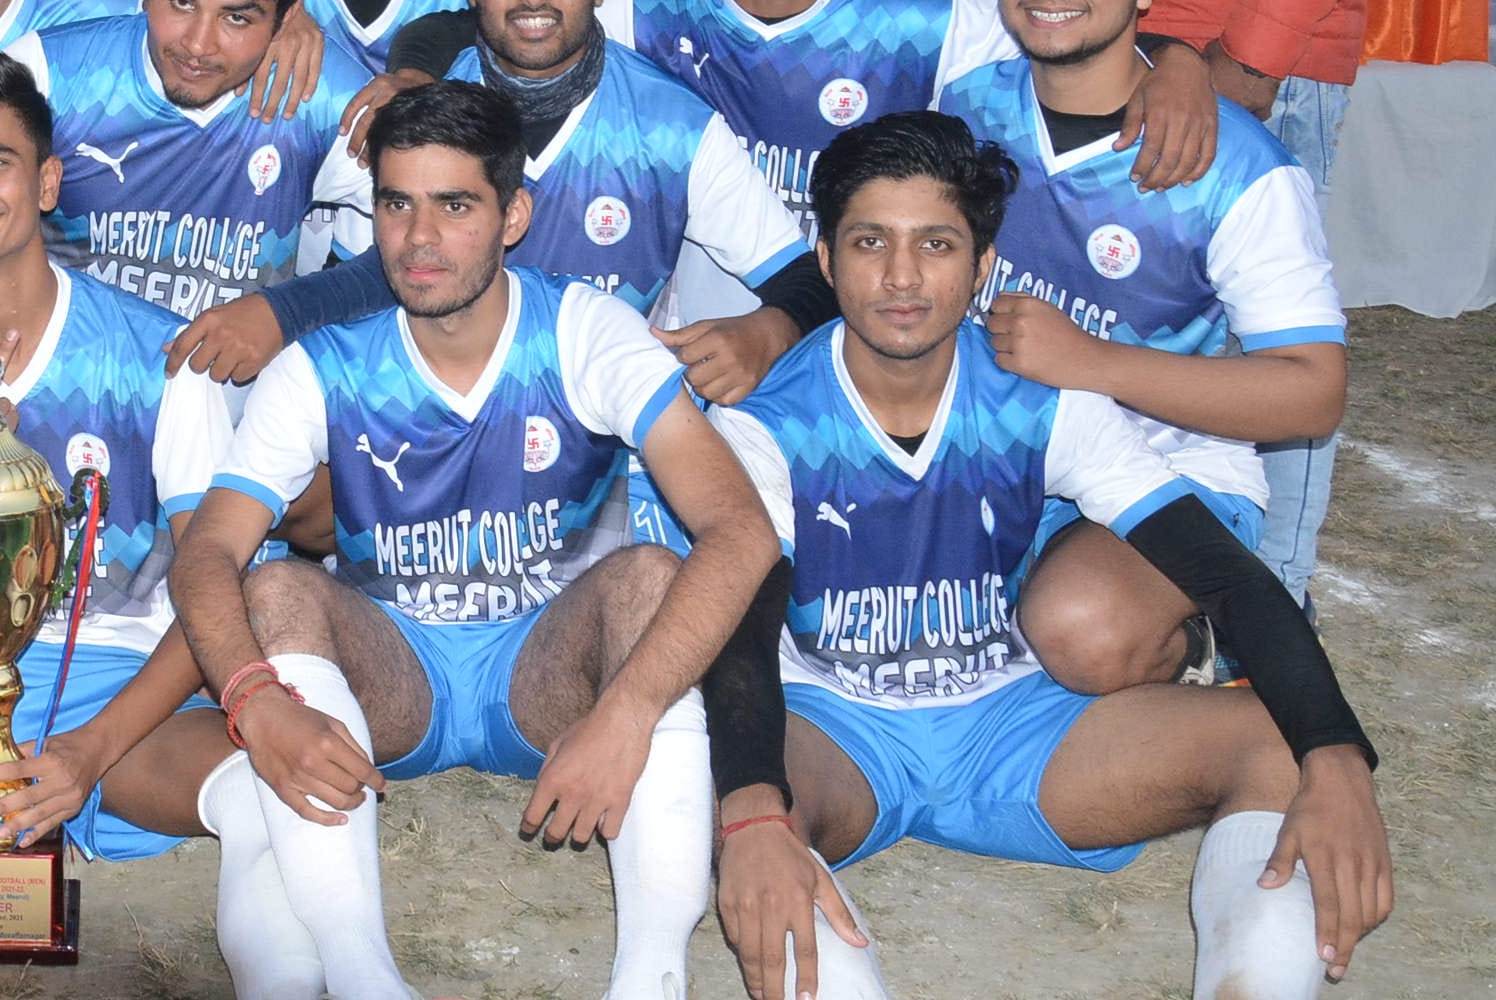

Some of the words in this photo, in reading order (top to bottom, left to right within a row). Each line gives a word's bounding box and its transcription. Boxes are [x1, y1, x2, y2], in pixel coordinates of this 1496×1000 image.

[173, 213, 265, 280] COLLGE
[374, 509, 473, 577] MEERUT
[816, 586, 918, 655] MEERUT
